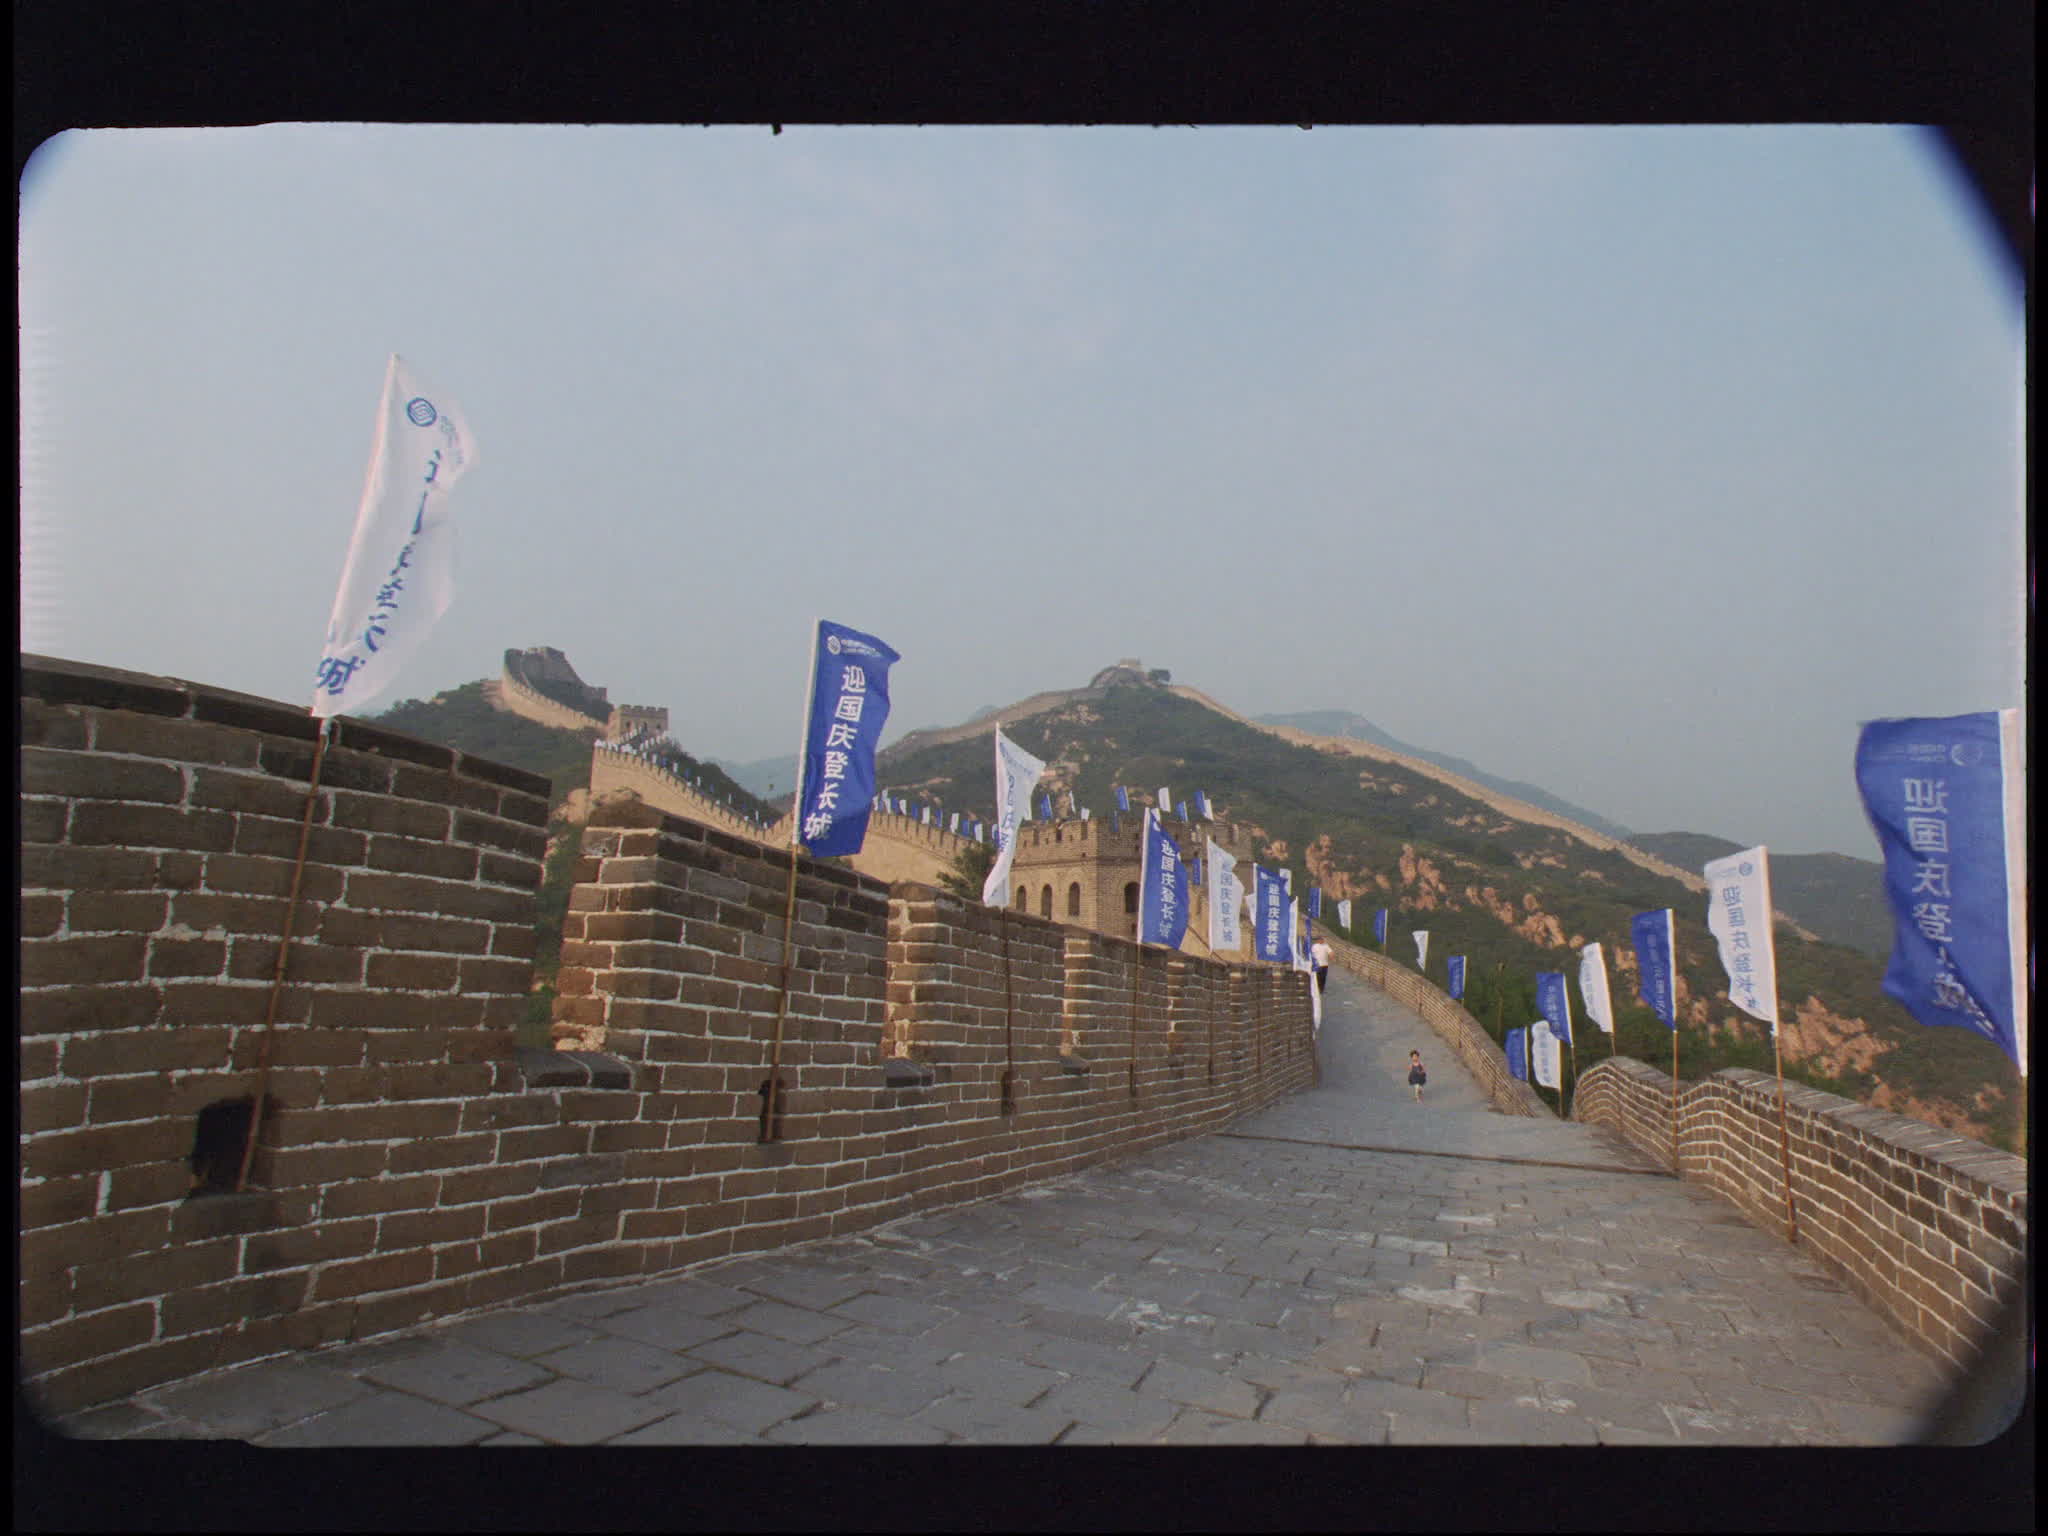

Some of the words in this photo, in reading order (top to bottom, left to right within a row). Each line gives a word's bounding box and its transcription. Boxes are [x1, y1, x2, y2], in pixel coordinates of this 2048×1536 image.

[803, 665, 867, 840] 迎国庆登长城
